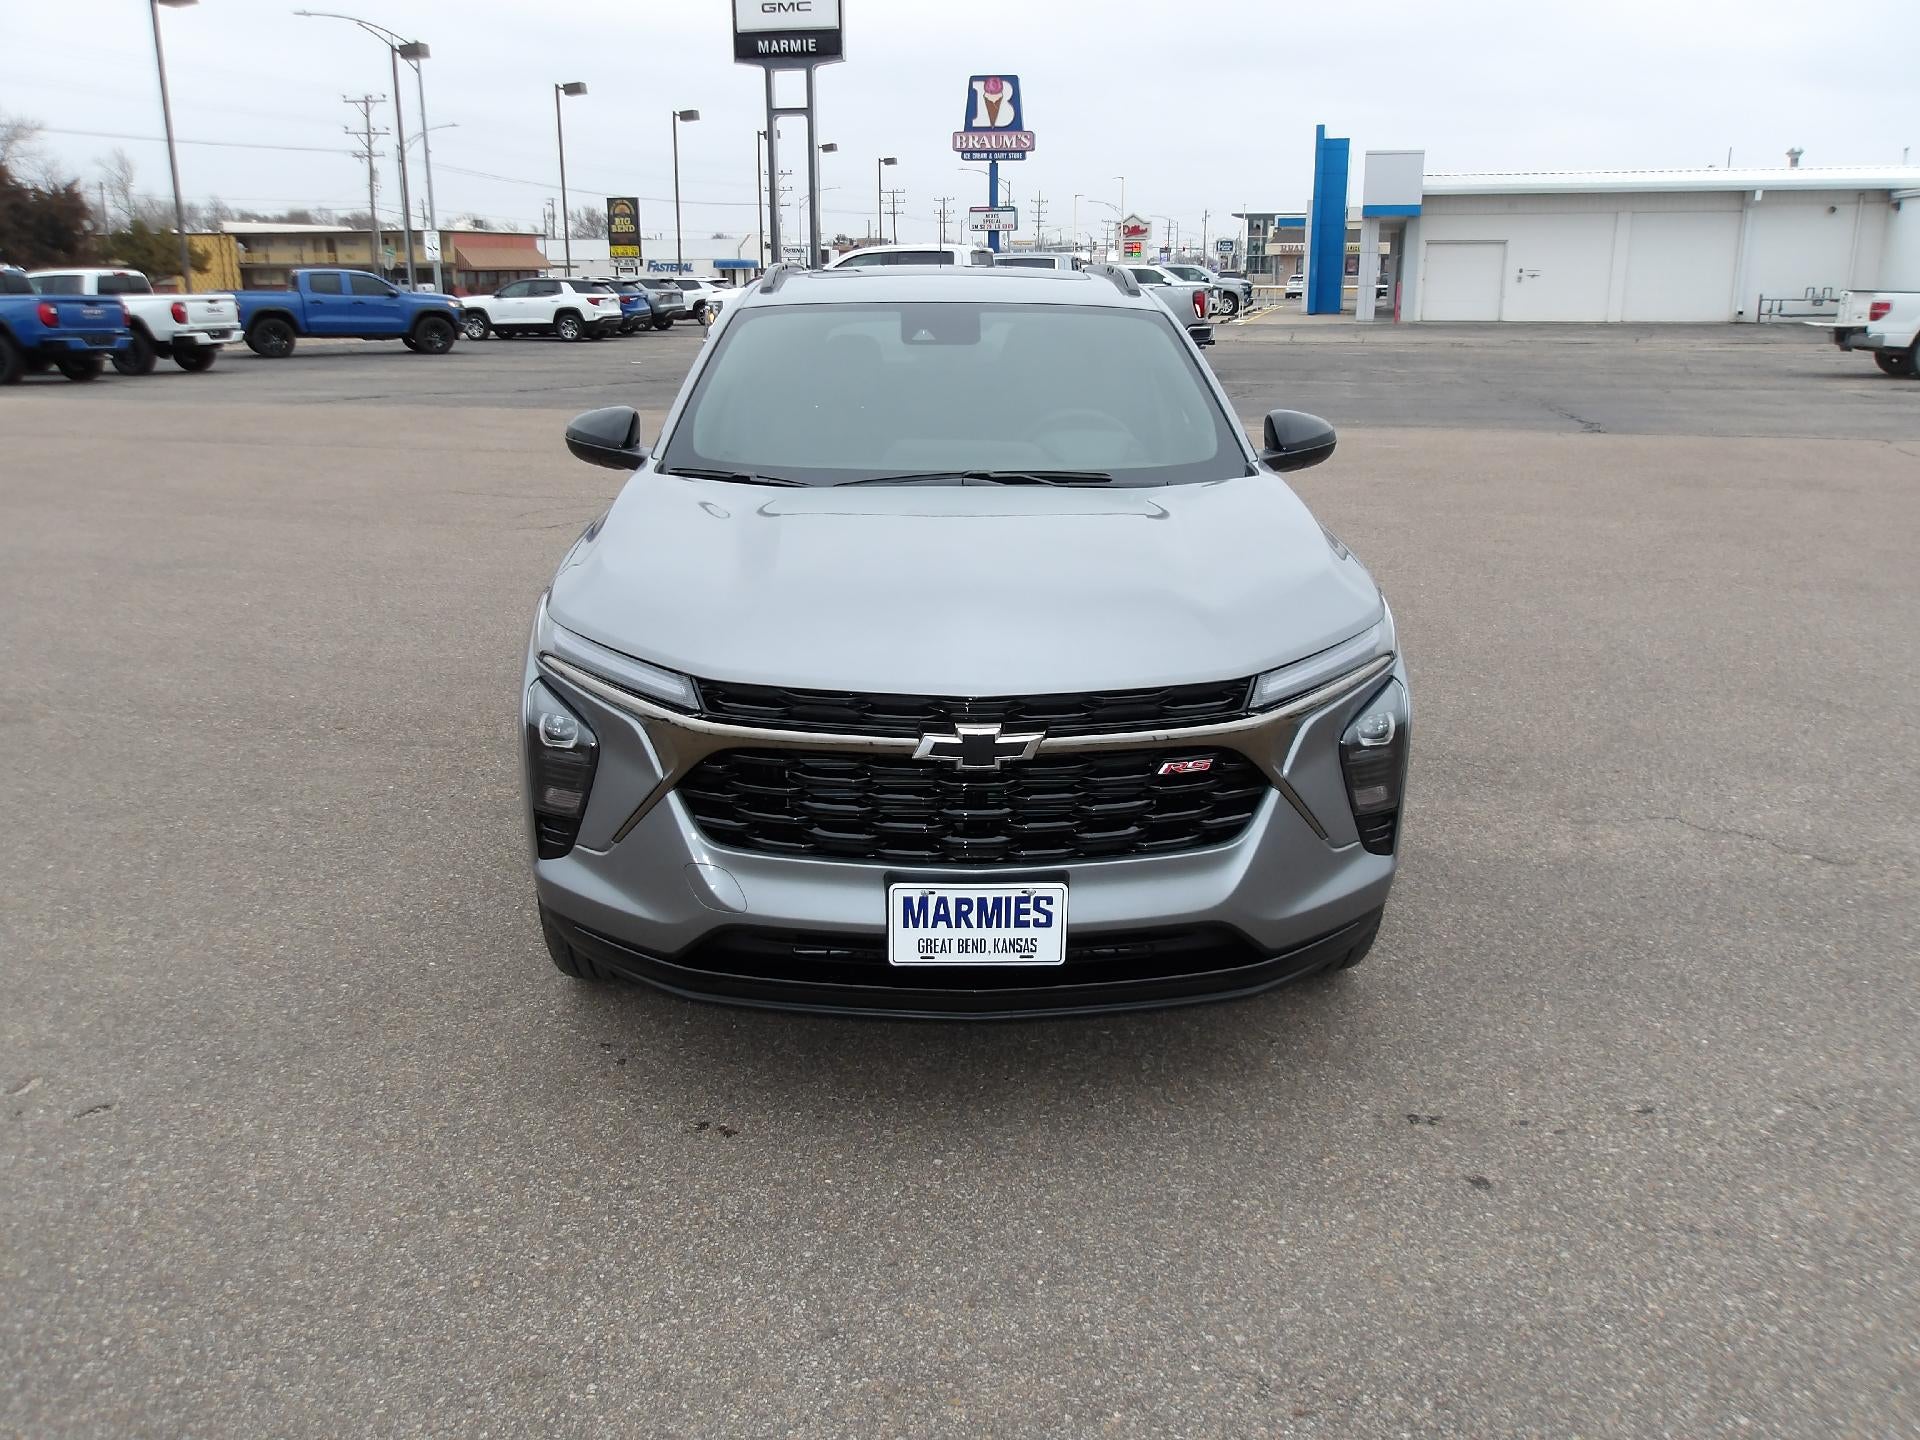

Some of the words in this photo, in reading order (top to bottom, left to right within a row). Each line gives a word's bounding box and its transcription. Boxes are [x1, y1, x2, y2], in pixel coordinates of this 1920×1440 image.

[761, 1, 811, 13] GMC
[757, 38, 817, 54] MARMIE
[955, 134, 1031, 149] BRAUM'S
[611, 224, 636, 233] BEND
[615, 217, 631, 225] BIG
[1158, 759, 1213, 774] RS
[902, 895, 1054, 929] MARMIES
[917, 937, 953, 954] GREAT
[957, 937, 991, 955] BEND,
[993, 937, 1038, 953] KANSAS
